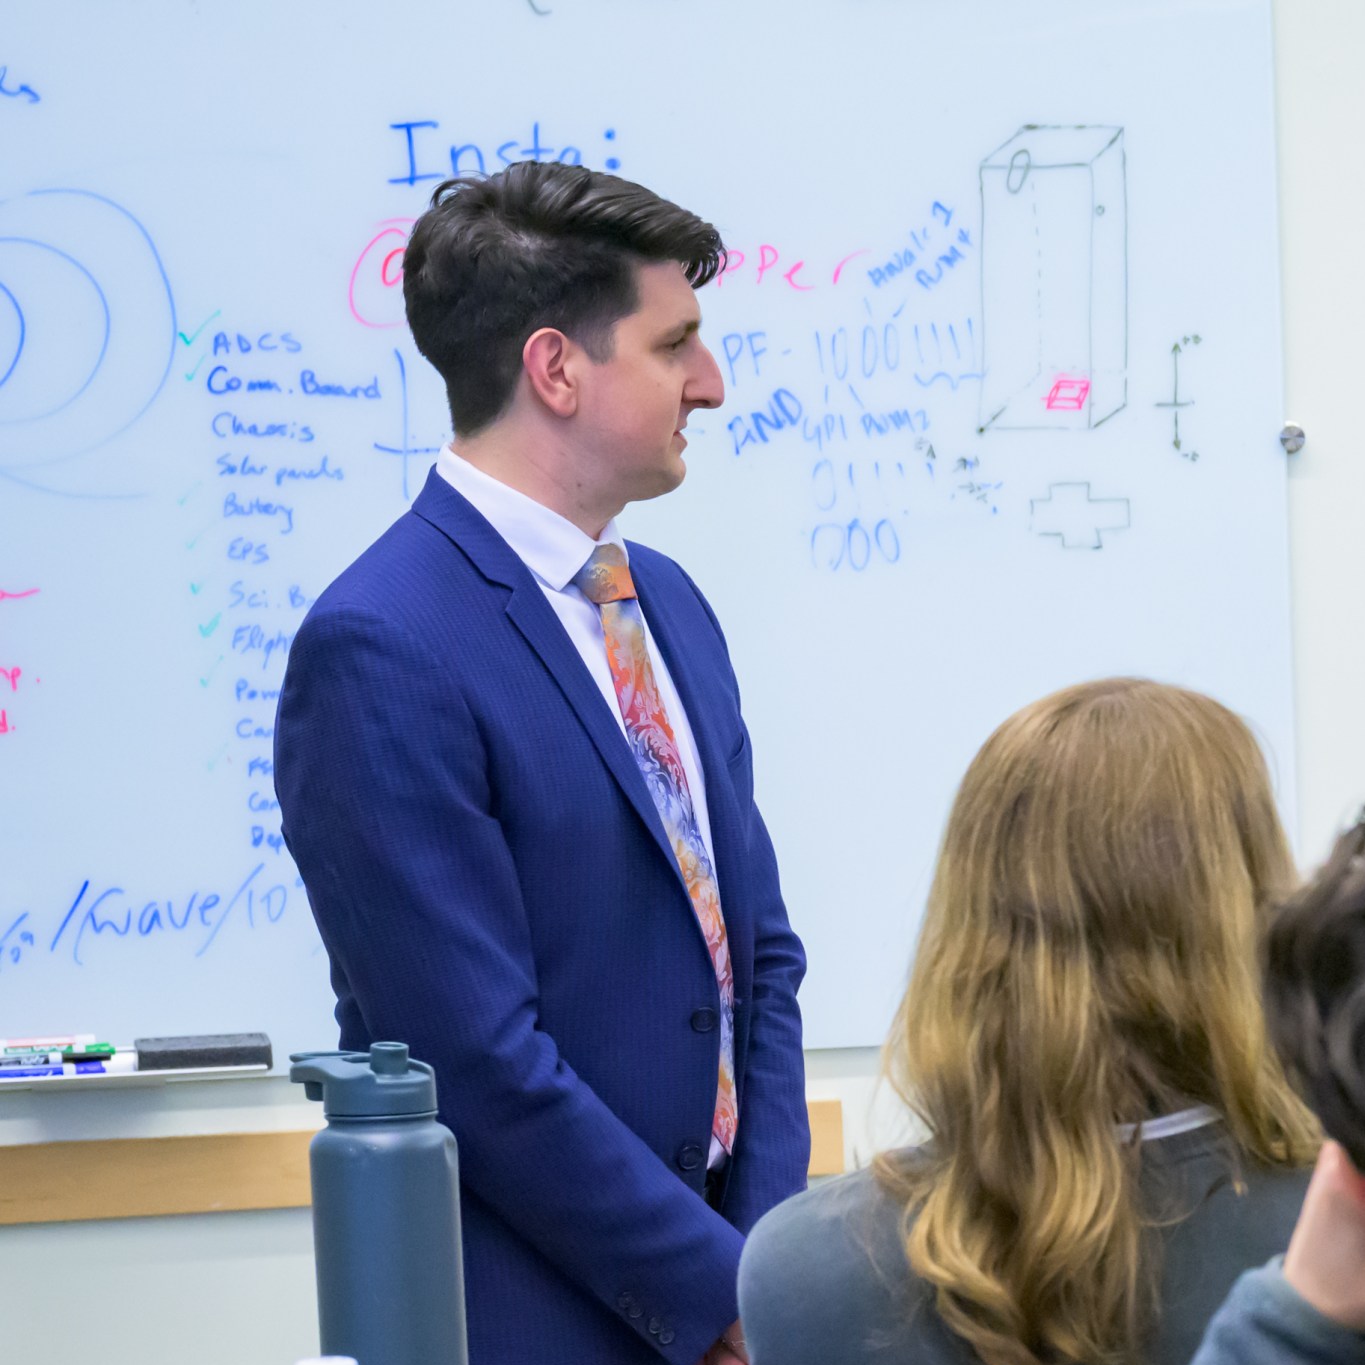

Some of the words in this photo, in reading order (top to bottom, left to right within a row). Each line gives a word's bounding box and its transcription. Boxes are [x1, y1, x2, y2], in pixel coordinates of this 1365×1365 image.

[213, 331, 303, 357] ADCS
[216, 452, 268, 478] Solar
[222, 491, 295, 536] Battery
[226, 536, 270, 565] EPS
